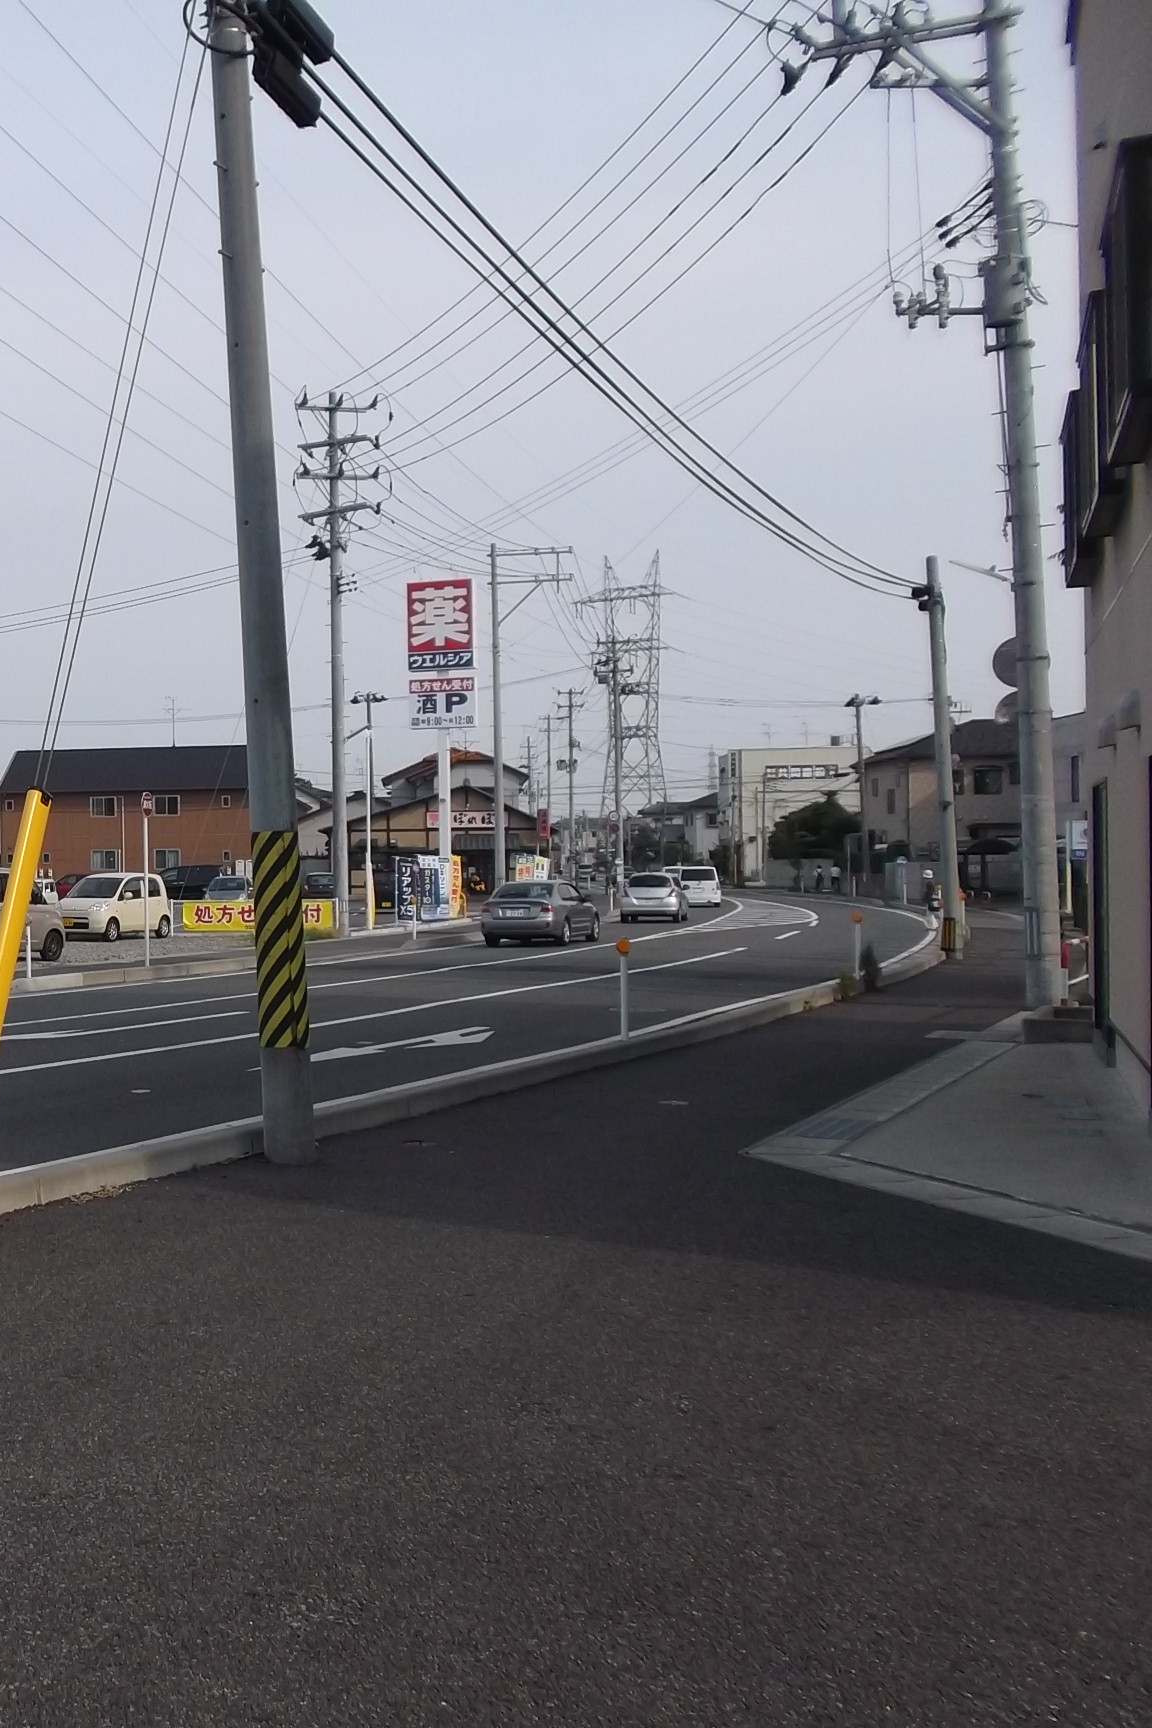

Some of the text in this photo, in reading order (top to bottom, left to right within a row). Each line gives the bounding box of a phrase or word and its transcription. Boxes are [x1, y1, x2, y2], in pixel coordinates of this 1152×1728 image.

[410, 586, 470, 646] 薬
[409, 652, 472, 668] ウエルシア
[411, 679, 473, 692] 処方せん受付
[416, 692, 468, 714] 酒 P
[454, 812, 496, 826] ぽれぽ
[195, 905, 322, 924] 処方せ付
